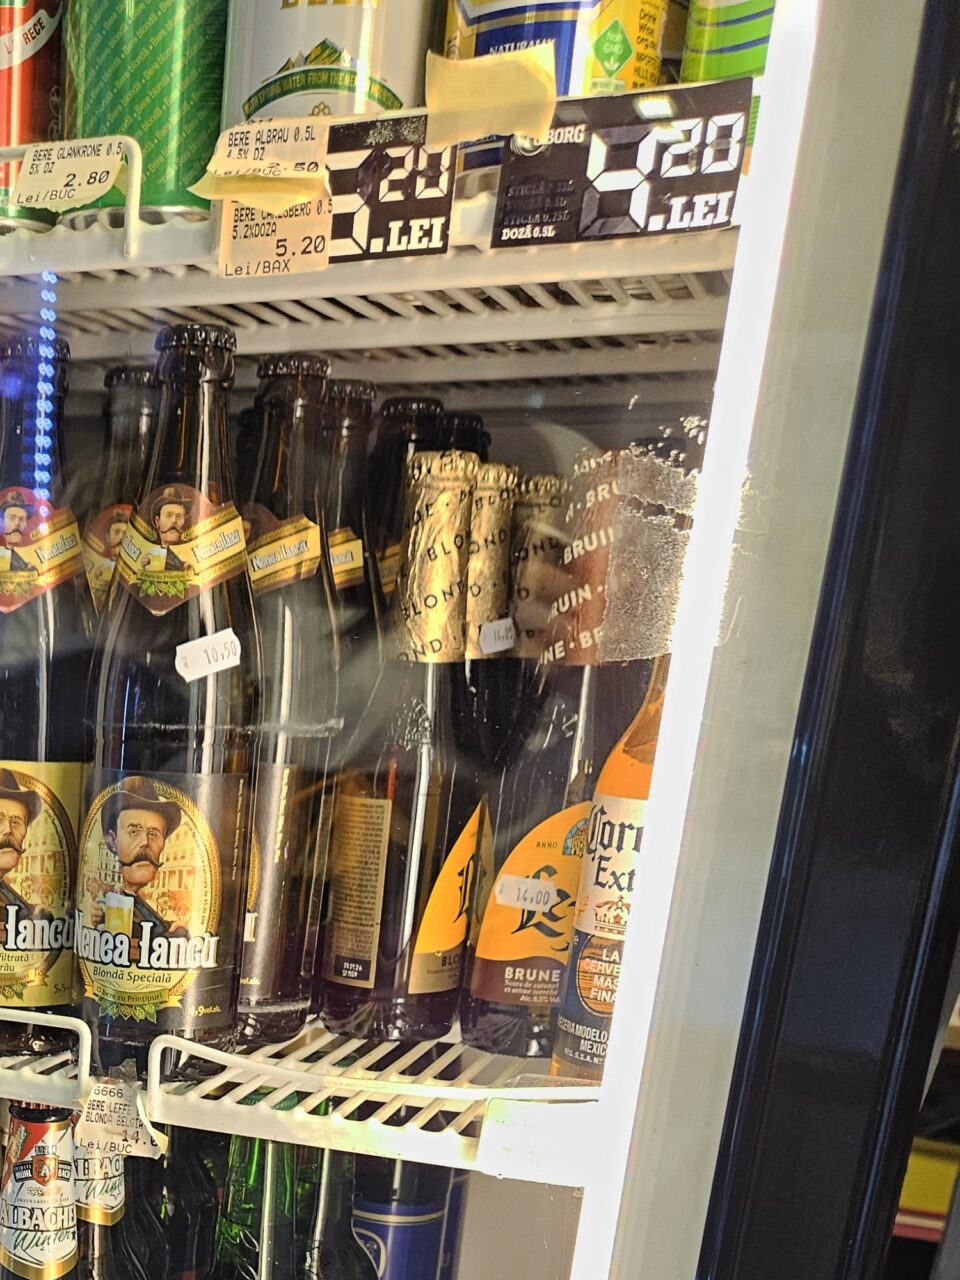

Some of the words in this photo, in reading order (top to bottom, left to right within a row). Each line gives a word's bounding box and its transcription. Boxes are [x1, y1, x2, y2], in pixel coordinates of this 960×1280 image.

[23, 18, 46, 46] RECE
[228, 132, 253, 147] BERE
[255, 128, 289, 145] ALBRAU
[293, 125, 316, 141] 0.5L
[659, 112, 746, 178] 20
[33, 149, 53, 162] BERE
[57, 143, 103, 159] GLANKRONE
[64, 170, 110, 189] 2.80
[379, 146, 452, 202] 20
[16, 188, 77, 205] Lei/BUC
[233, 206, 256, 223] BERE
[666, 191, 735, 230] LEI
[387, 216, 446, 252] LEI
[501, 227, 532, 240] DOZĂ
[533, 225, 556, 239] 0.5L
[275, 235, 325, 257] 5.20
[224, 258, 290, 277] Lei/BAX
[203, 640, 239, 665] 10,50
[536, 840, 559, 849] ANNO
[516, 887, 551, 906] 14,00
[5, 904, 74, 951] Iancu
[74, 910, 131, 966] Nenea
[137, 922, 221, 970] Iancu
[602, 948, 620, 962] LA
[93, 965, 125, 982] Blondă
[127, 970, 172, 984] Specială
[504, 966, 561, 982] BRUNE
[583, 958, 621, 976] CERVE
[575, 1023, 608, 1042] MODELO
[93, 1086, 124, 1099] 6666
[87, 1099, 105, 1112] BERE
[85, 1111, 113, 1125] BLONDA
[79, 1138, 133, 1154] Lei/BUC
[13, 1228, 73, 1252] Winter
